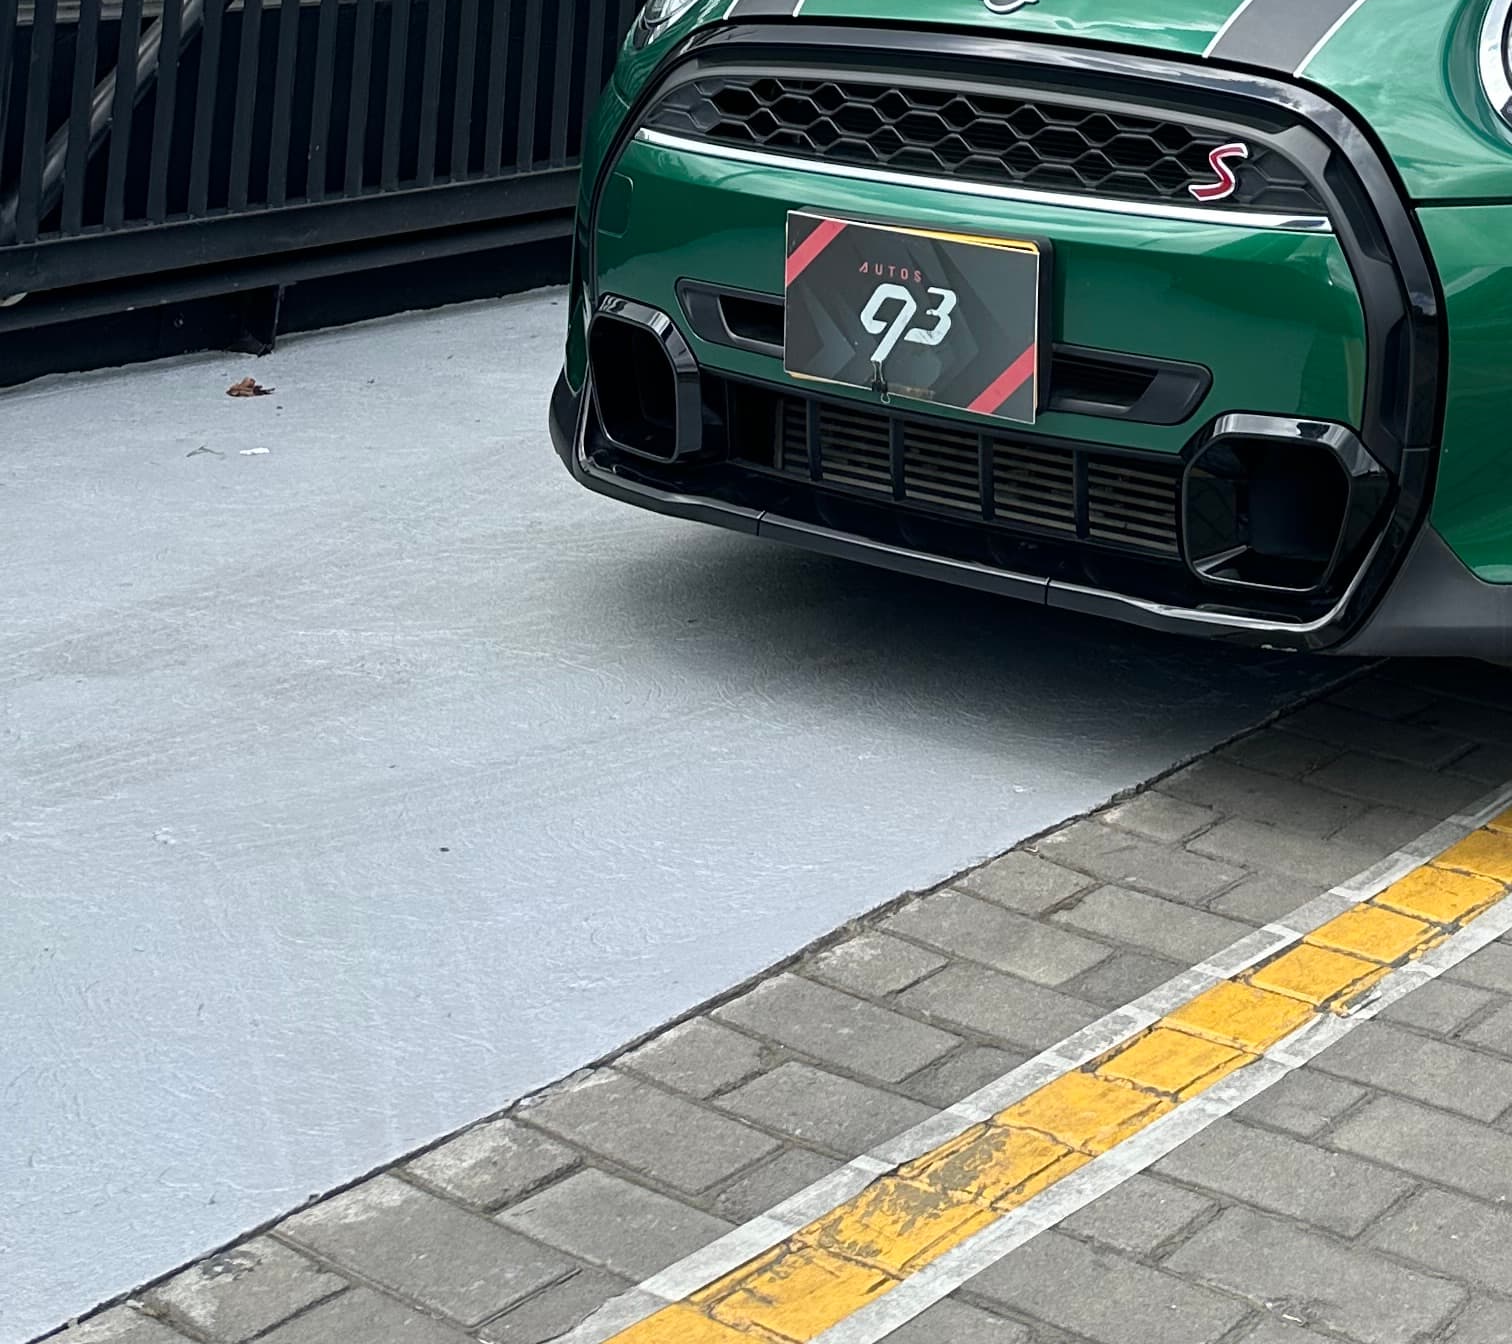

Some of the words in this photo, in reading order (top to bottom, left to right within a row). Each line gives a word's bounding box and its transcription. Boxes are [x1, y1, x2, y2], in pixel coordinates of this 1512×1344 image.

[1188, 143, 1248, 201] S
[859, 261, 923, 283] AUTOS
[860, 283, 957, 362] 93
